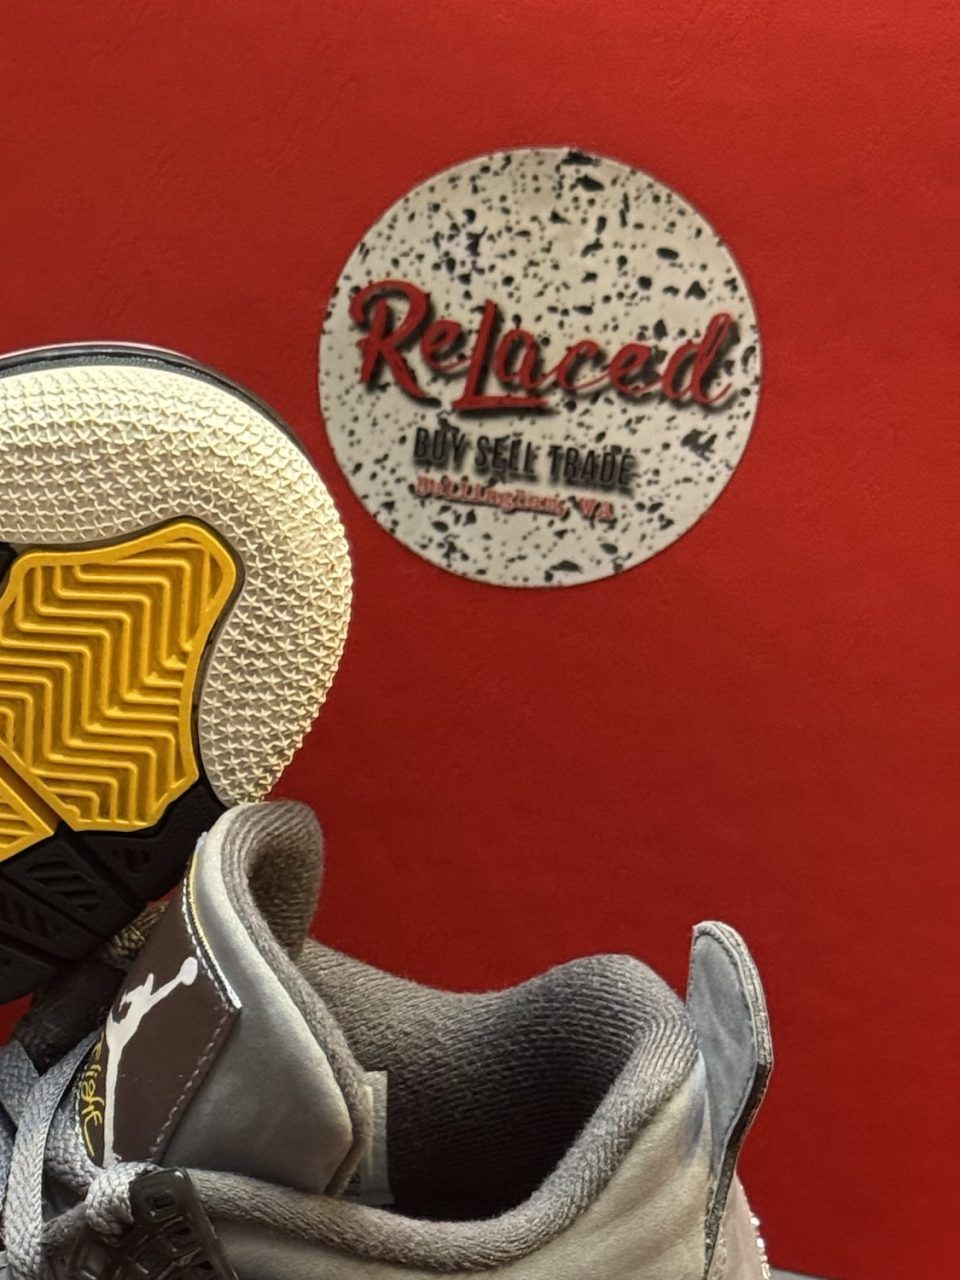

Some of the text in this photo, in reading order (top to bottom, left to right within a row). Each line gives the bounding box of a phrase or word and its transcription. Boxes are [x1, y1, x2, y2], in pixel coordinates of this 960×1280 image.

[414, 427, 635, 487] BUY SELL TRADE
[579, 496, 615, 519] WA
